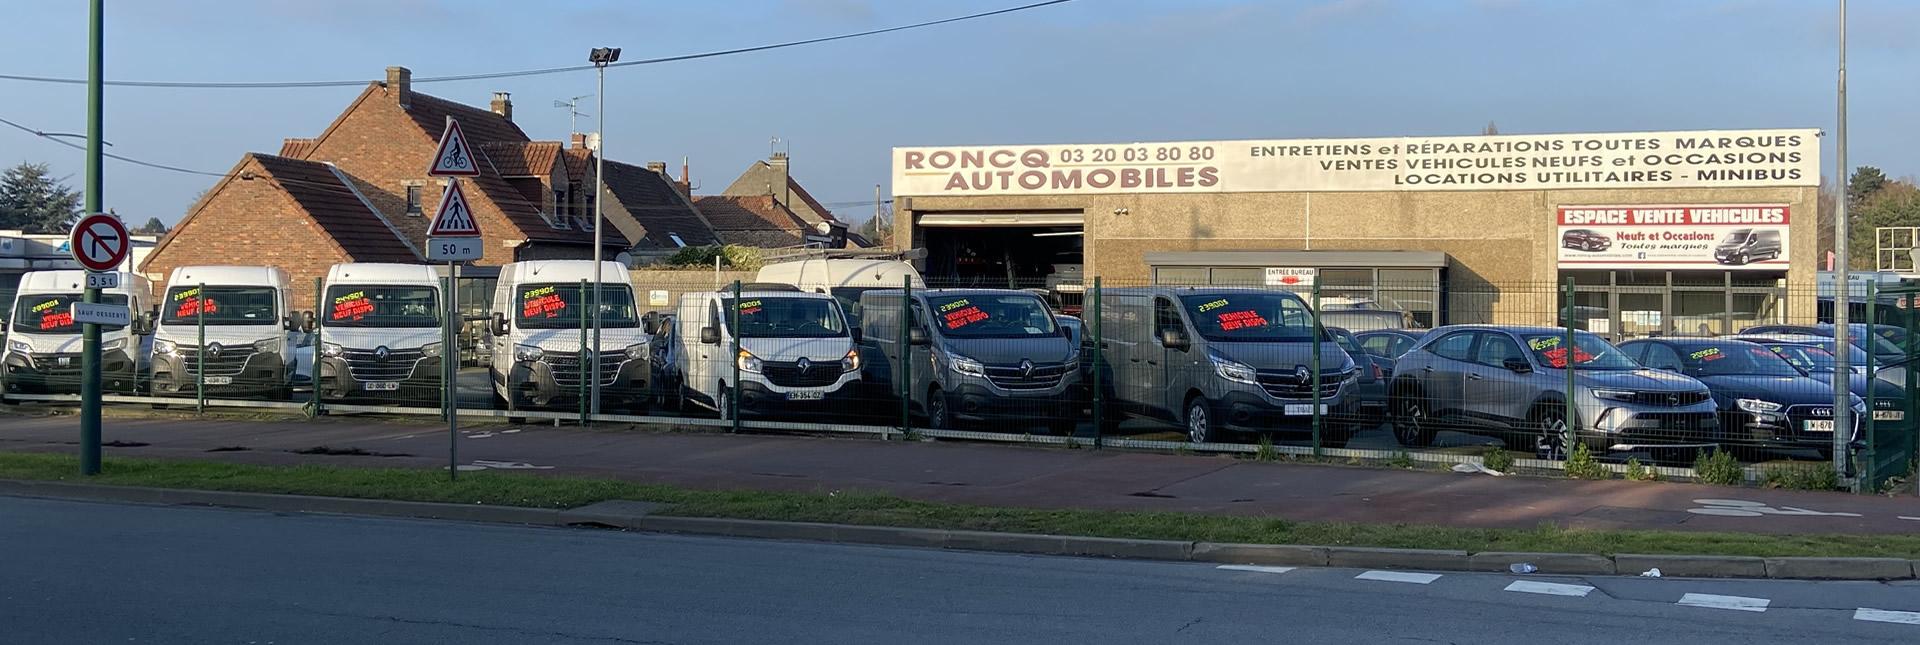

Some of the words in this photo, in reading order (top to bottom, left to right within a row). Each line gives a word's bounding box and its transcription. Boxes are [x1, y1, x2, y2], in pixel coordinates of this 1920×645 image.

[1060, 148, 1084, 163] 03
[1092, 148, 1117, 162] 20
[1123, 147, 1148, 162] 03
[1156, 146, 1181, 161] 80
[1188, 146, 1215, 160] 80
[1250, 144, 1372, 157] ENTRETIENS
[1378, 144, 1400, 155] et
[1406, 139, 1564, 155] RÉPARATIONS
[1571, 138, 1660, 151] TOUTES
[1675, 135, 1801, 149] MARQUES
[905, 149, 1050, 169] RONCQ
[1319, 158, 1398, 171] VENTES
[1406, 156, 1527, 170] VEHICULES
[1532, 155, 1603, 168] NEUFS
[1611, 155, 1635, 167] et
[1643, 151, 1802, 166] OCCASIONS
[945, 167, 1219, 190] AUTOMOBILES
[1394, 172, 1527, 185] LOCATIONS
[1537, 170, 1673, 184] UTILITAIRES
[1697, 168, 1802, 181] MINIBUS
[1564, 209, 1627, 224] ESPACE
[1633, 209, 1685, 223] VENTE
[1690, 208, 1784, 223] VEHICULES
[1616, 231, 1645, 241] Neufs
[1649, 232, 1659, 240] et
[1663, 231, 1715, 241] Occasions
[442, 244, 456, 255] 50
